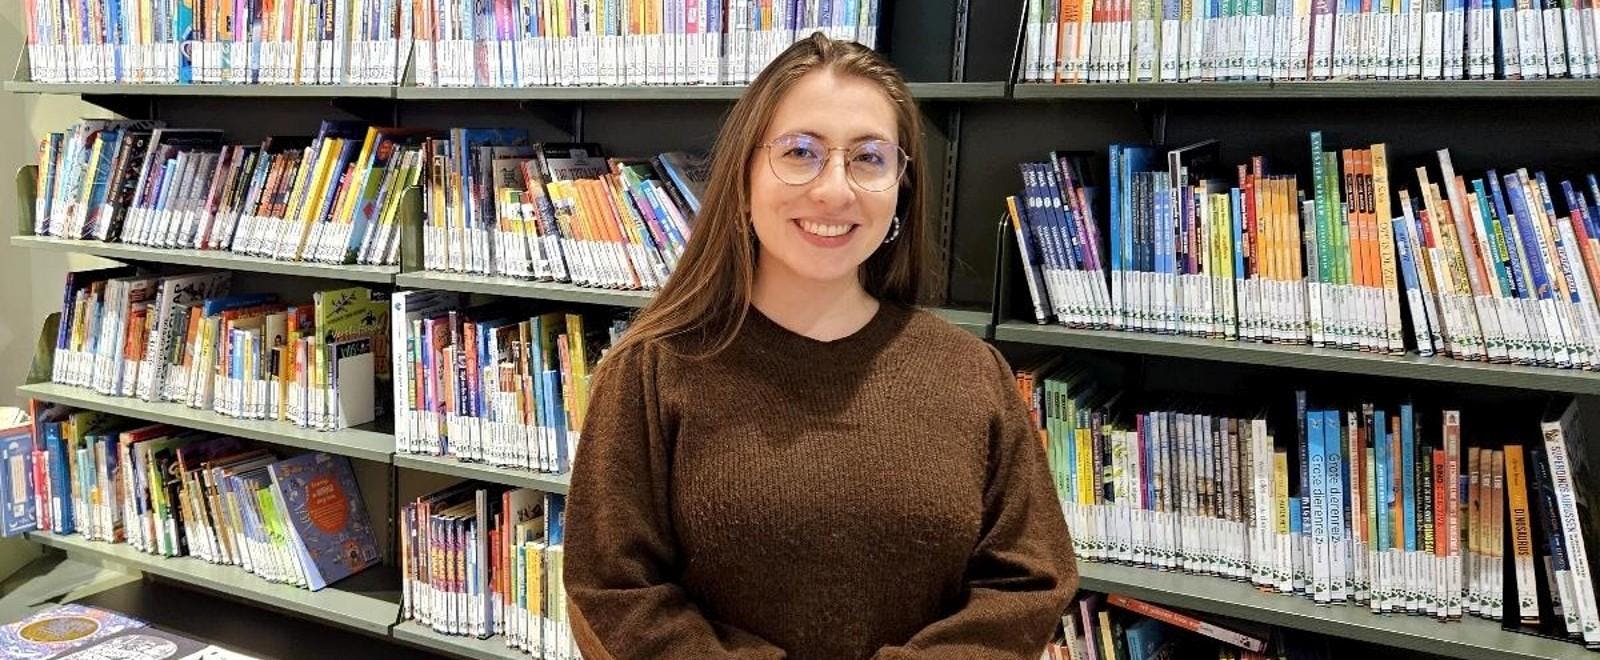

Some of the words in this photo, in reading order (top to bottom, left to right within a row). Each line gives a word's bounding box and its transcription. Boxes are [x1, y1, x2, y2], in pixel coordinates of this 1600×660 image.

[1312, 453, 1323, 486] Grote
[1329, 453, 1341, 485] Grote
[1551, 446, 1577, 533] SUPERDINOSAURUSSEN
[1312, 488, 1325, 544] dierenreiz
[1330, 487, 1342, 544] dierenreiz
[1514, 508, 1529, 556] DINOSAURUS
